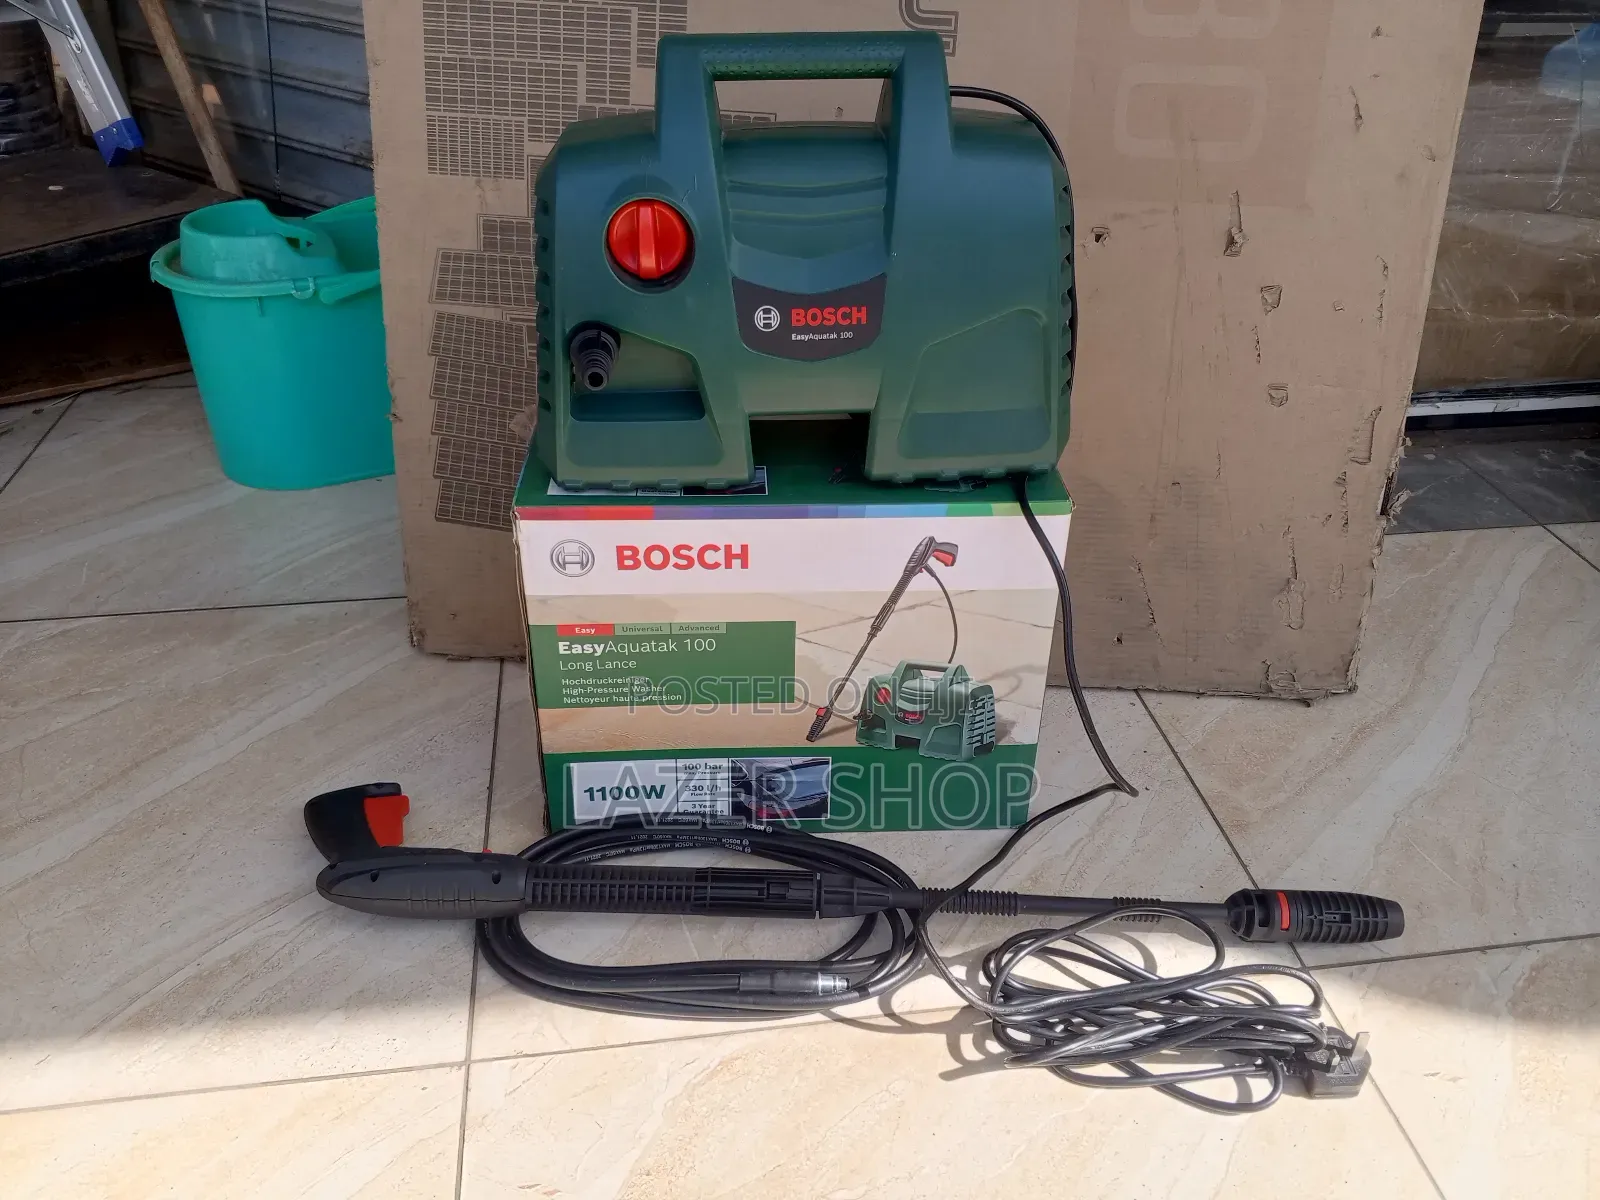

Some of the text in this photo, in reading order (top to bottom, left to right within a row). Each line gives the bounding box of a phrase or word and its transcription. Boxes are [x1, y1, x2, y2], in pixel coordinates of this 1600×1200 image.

[791, 306, 867, 327] BOSCH
[791, 331, 853, 341] EasyAquatak 100
[615, 543, 749, 571] BOSCH
[621, 625, 663, 633] Universal
[678, 624, 720, 632] Advanced
[558, 638, 716, 656] EasyAquatak 100
[559, 659, 637, 671] Long Lance
[561, 676, 650, 686] Hochdruckreiniger
[562, 685, 666, 695] High-Pressure Washer
[563, 694, 682, 704] Nettoyeur haute pression
[682, 762, 724, 771] 100 bar
[583, 785, 666, 802] 1100W
[721, 837, 741, 845] BOSCH
